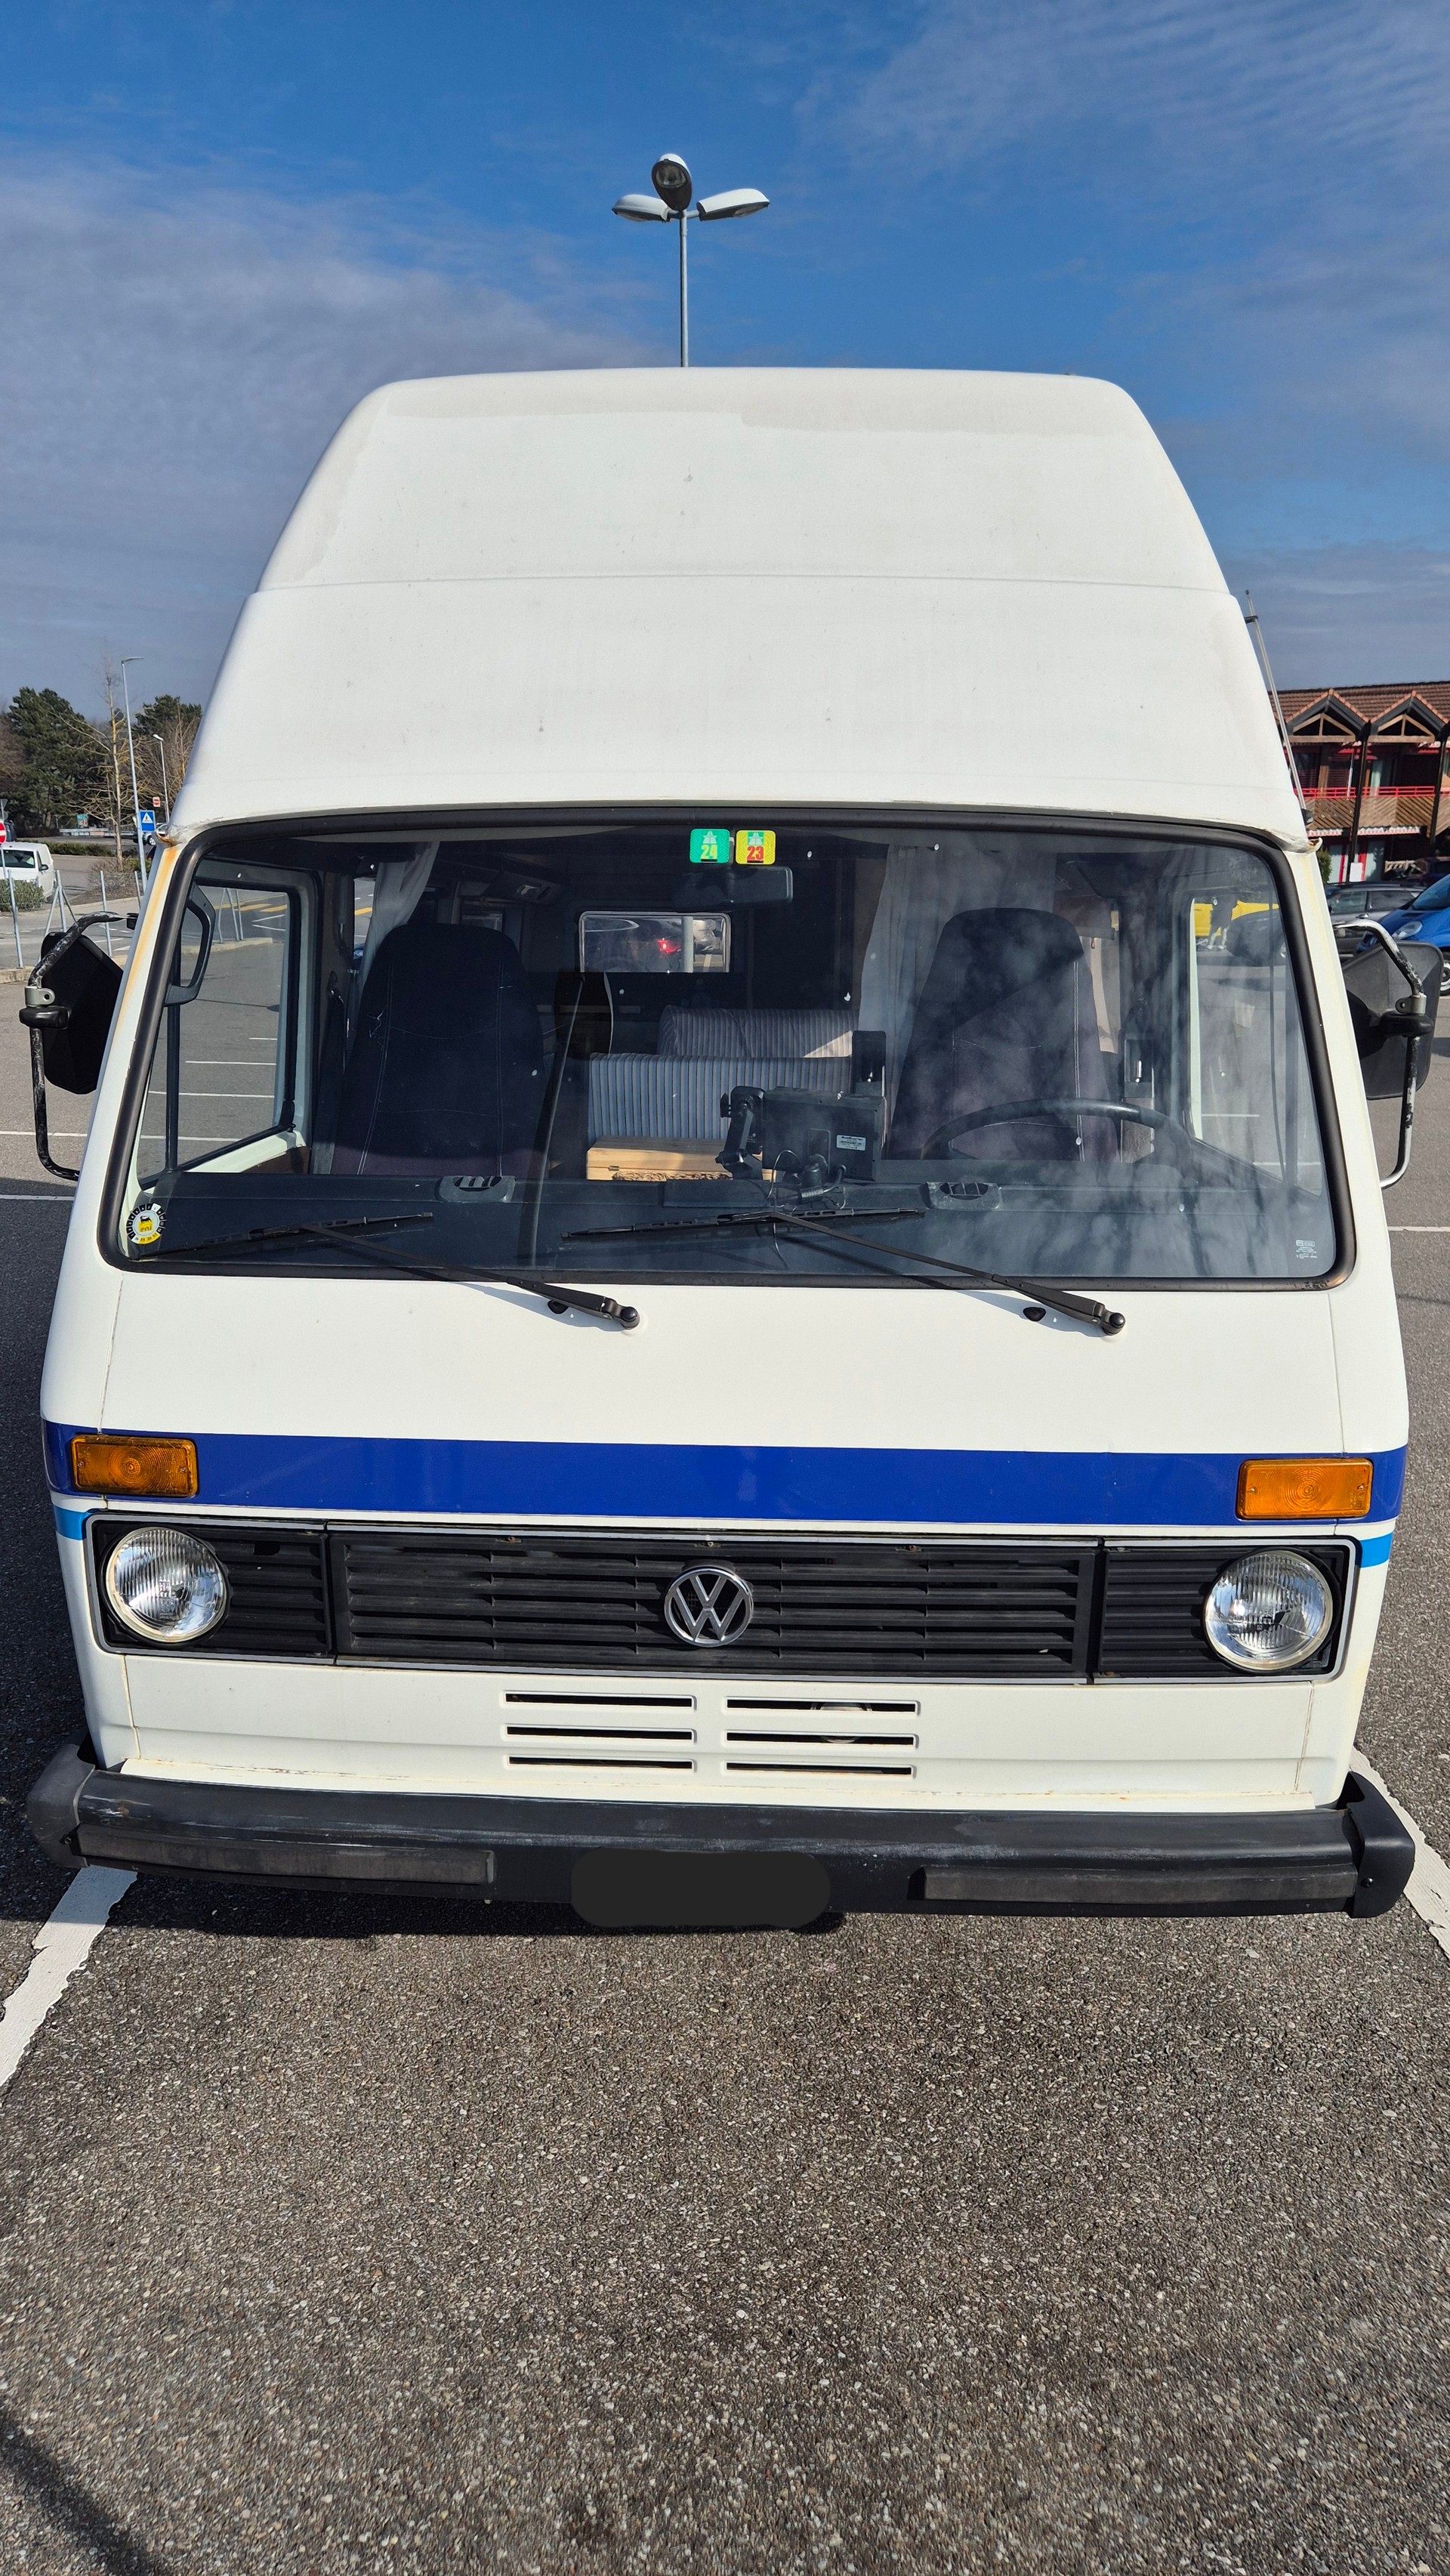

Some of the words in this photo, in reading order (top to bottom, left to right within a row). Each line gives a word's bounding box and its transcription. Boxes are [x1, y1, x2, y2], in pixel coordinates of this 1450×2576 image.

[701, 845, 717, 859] 24
[747, 845, 764, 860] 23
[671, 1571, 747, 1643] VW
